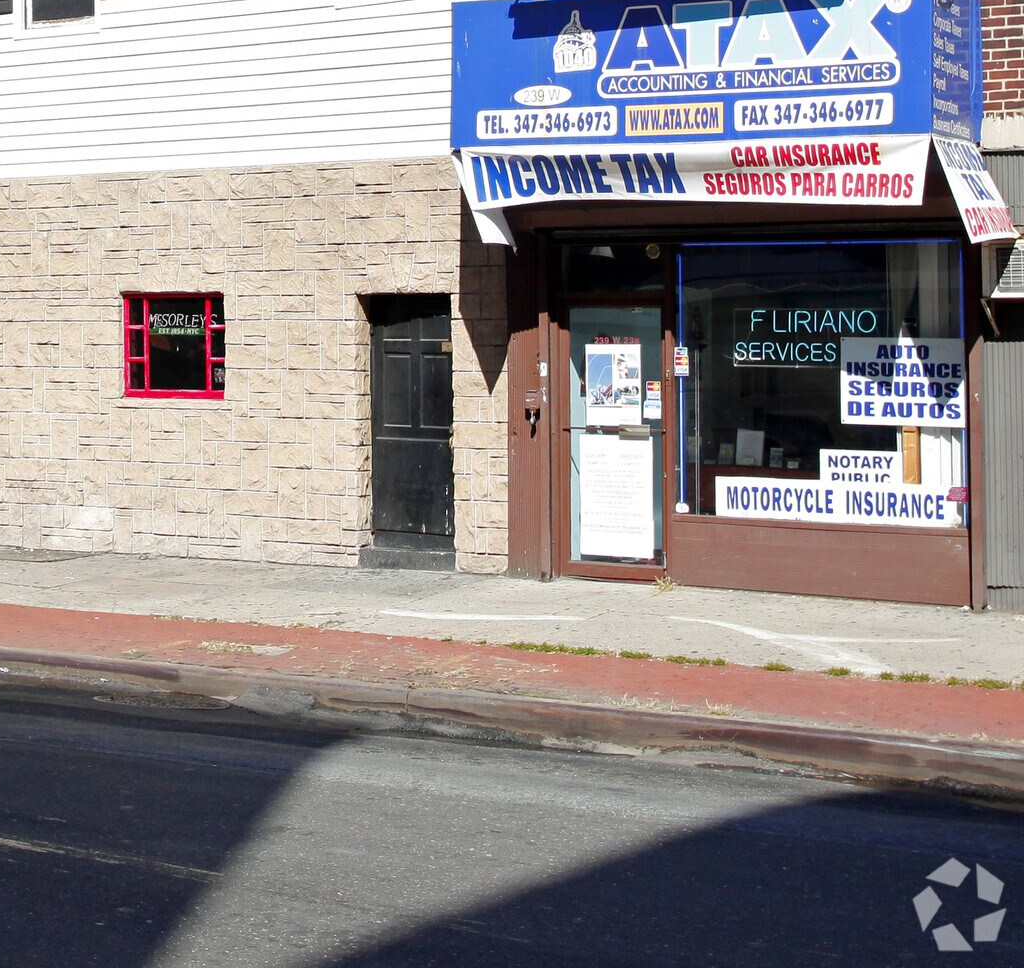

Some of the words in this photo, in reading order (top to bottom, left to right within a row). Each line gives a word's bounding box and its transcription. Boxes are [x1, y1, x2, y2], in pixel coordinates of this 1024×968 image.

[933, 12, 952, 33] Corporate
[951, 20, 962, 38] Taxes
[933, 33, 944, 50] Sales
[944, 37, 955, 54] Taxes
[555, 47, 593, 69] 1040
[933, 53, 942, 69] Self
[941, 56, 959, 77] Employed
[958, 62, 969, 81] Taxes
[608, 73, 707, 93] ACCOUNTING
[715, 72, 726, 88] &
[734, 67, 813, 87] FINANCIAL
[821, 63, 890, 84] SERVICES
[933, 73, 946, 91] Payroll
[523, 88, 545, 103] 239
[548, 87, 561, 101] W
[933, 94, 959, 116] Incorporations
[484, 115, 509, 134] TEL.
[514, 111, 611, 134] 347-346-6973
[629, 107, 719, 131] WWW.ATAX.COM
[741, 105, 768, 126] FAX
[774, 99, 884, 125] 347-346-6977
[933, 115, 950, 133] Business
[950, 119, 970, 139] Certificates
[731, 146, 769, 168] CAR
[772, 142, 881, 167] INSURANCE
[471, 154, 613, 202] INCOME
[610, 152, 686, 194] TAX
[703, 172, 787, 196] SEGUROS
[791, 172, 837, 197] PARA
[842, 173, 914, 199] CARROS
[961, 173, 995, 201] TAX
[751, 309, 766, 332] F
[772, 309, 877, 334] LIRIANO
[594, 336, 610, 344] 239
[612, 336, 621, 344] W
[734, 341, 836, 362] SERVICES
[876, 344, 929, 360] AUTO
[846, 362, 962, 378] INSURANCE
[848, 380, 960, 398] SEGUROS
[847, 401, 875, 417] DE
[881, 402, 961, 419] AUTOS
[828, 455, 894, 470] NOTARY
[726, 486, 834, 514] MOTORCYCLE
[846, 490, 945, 520] INSURANCE
